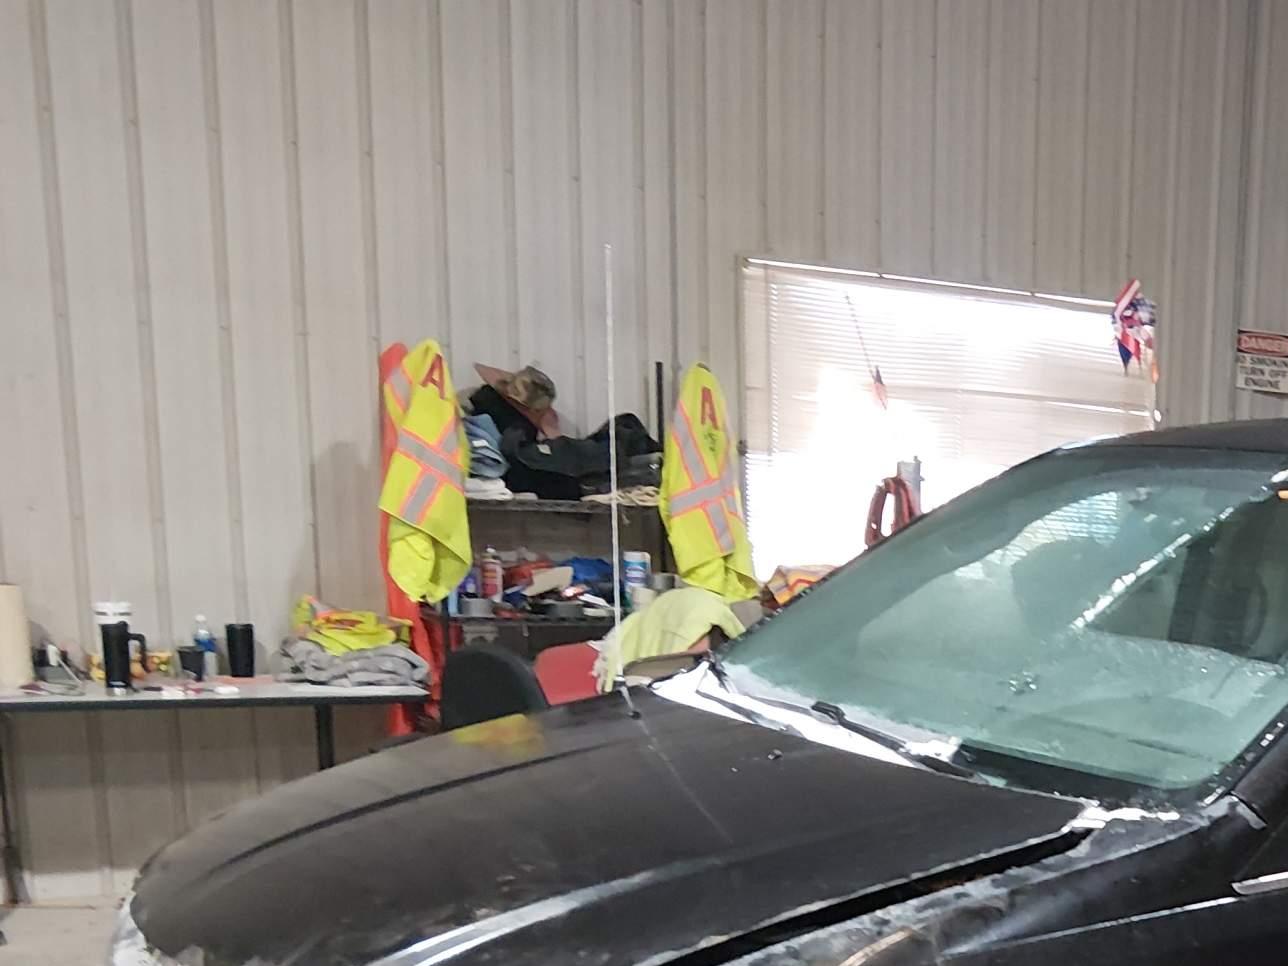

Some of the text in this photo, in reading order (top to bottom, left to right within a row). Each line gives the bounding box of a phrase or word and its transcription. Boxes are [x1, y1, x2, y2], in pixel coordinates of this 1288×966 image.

[420, 353, 446, 400] A
[1244, 377, 1281, 390] ENGINE
[1268, 369, 1288, 379] OFF
[701, 386, 719, 430] A
